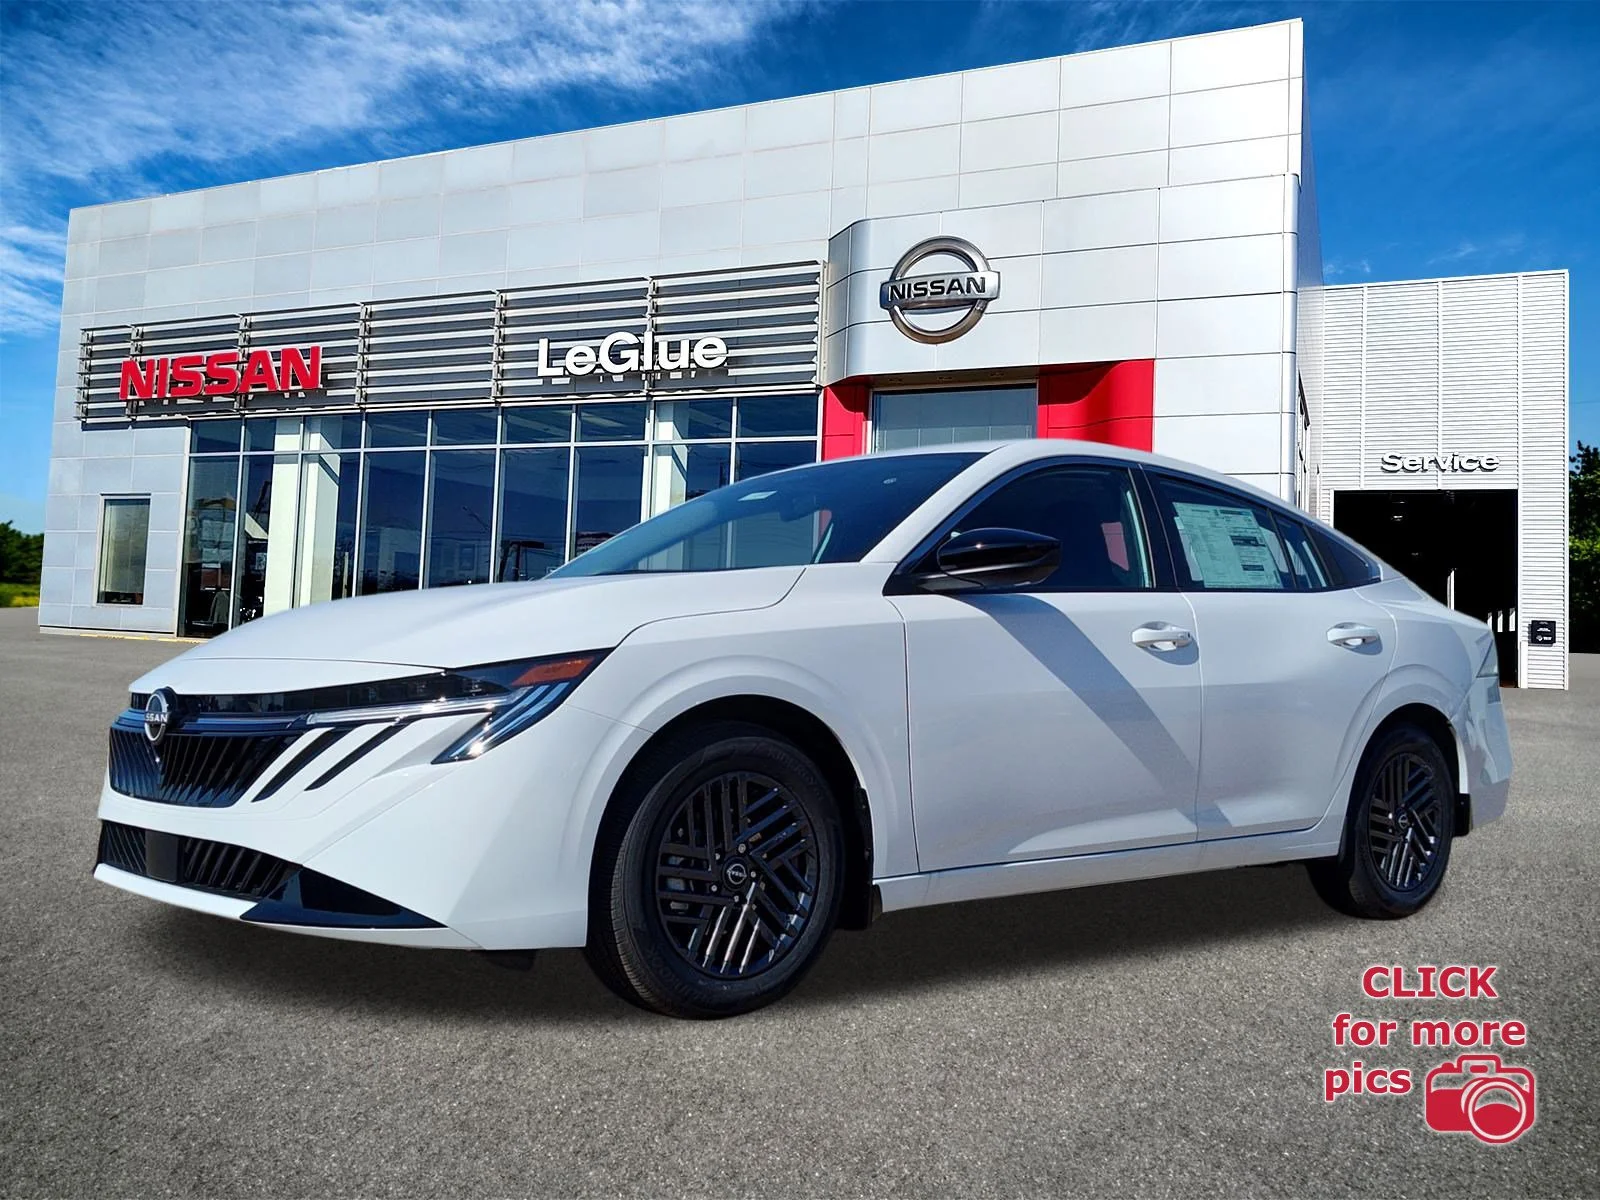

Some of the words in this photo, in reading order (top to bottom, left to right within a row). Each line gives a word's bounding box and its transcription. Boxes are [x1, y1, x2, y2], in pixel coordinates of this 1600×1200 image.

[887, 276, 986, 301] NISSAN
[537, 330, 728, 377] LeGlue
[119, 345, 322, 400] NISSAN
[1381, 451, 1500, 473] Service
[144, 712, 168, 723] SSAN
